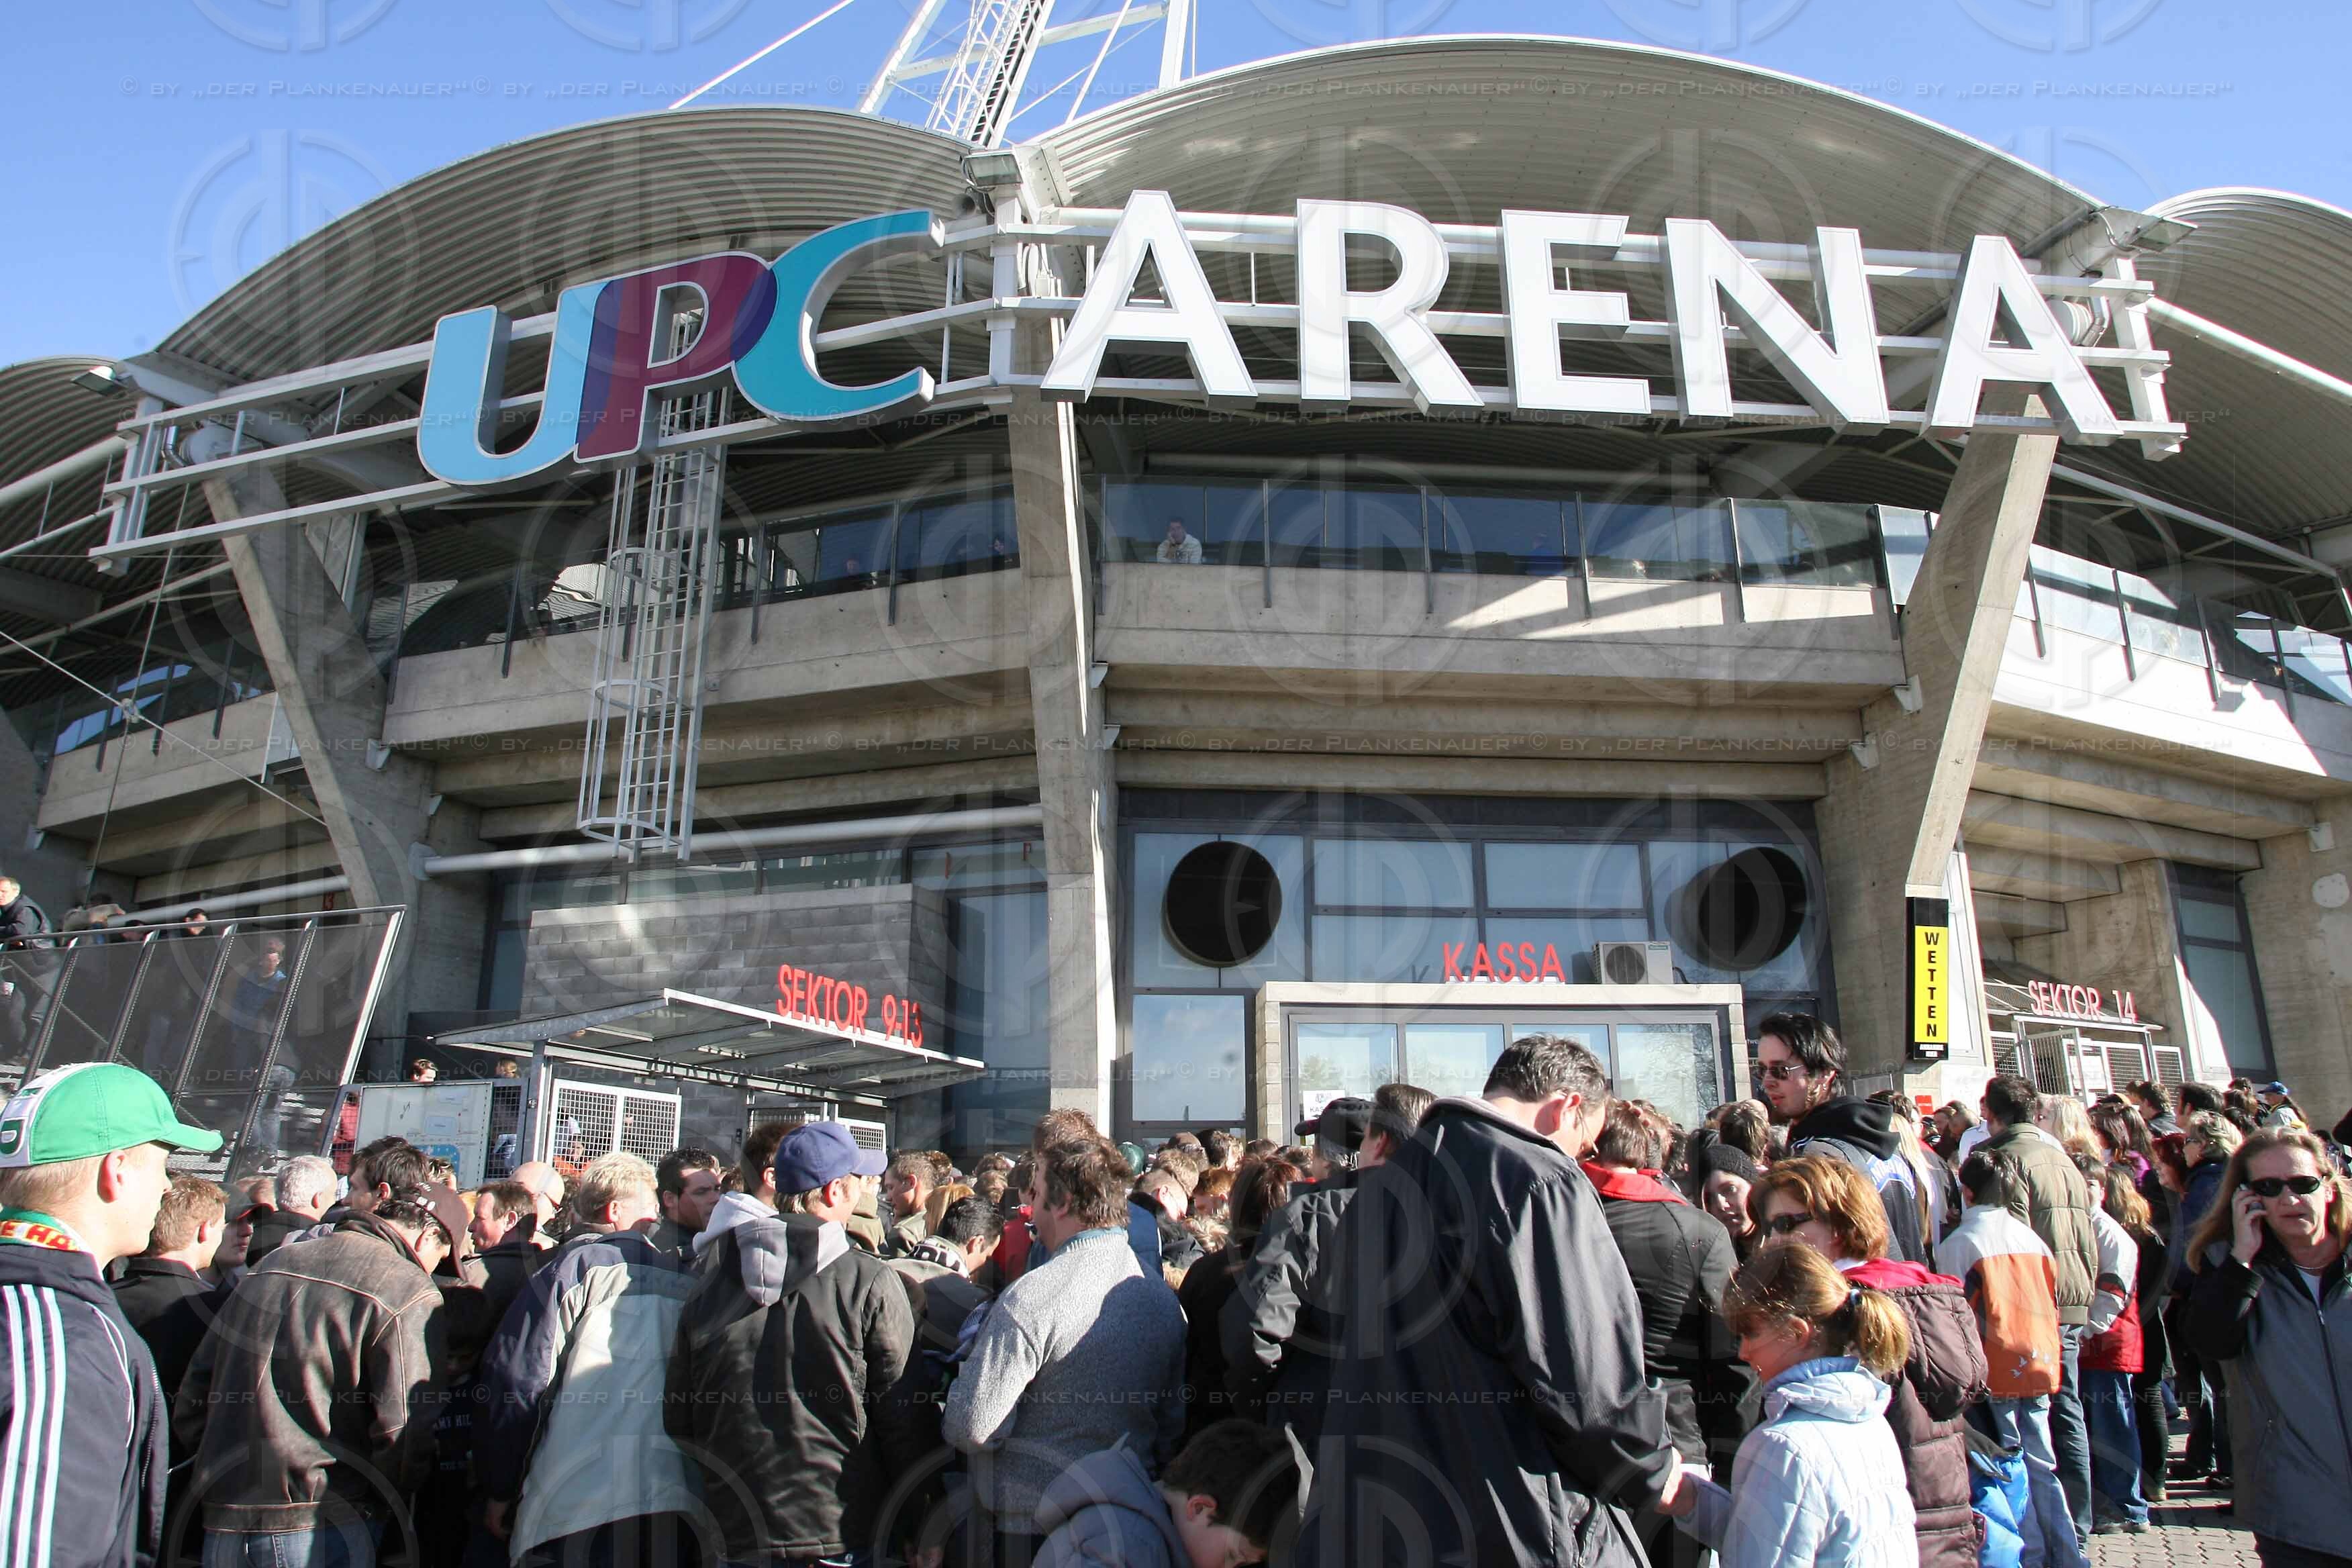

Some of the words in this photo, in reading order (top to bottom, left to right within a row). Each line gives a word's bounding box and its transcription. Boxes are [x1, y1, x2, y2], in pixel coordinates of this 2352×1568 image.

[416, 209, 941, 486] UPC
[1040, 190, 2124, 436] ARENA
[1443, 942, 1566, 983] KASSA
[1924, 932, 1939, 1037] WETTEN
[2028, 980, 2102, 1021] SEKTOR
[2112, 989, 2138, 1024] 14
[777, 963, 868, 1035] SEKTOR
[882, 994, 923, 1048] 9-13
